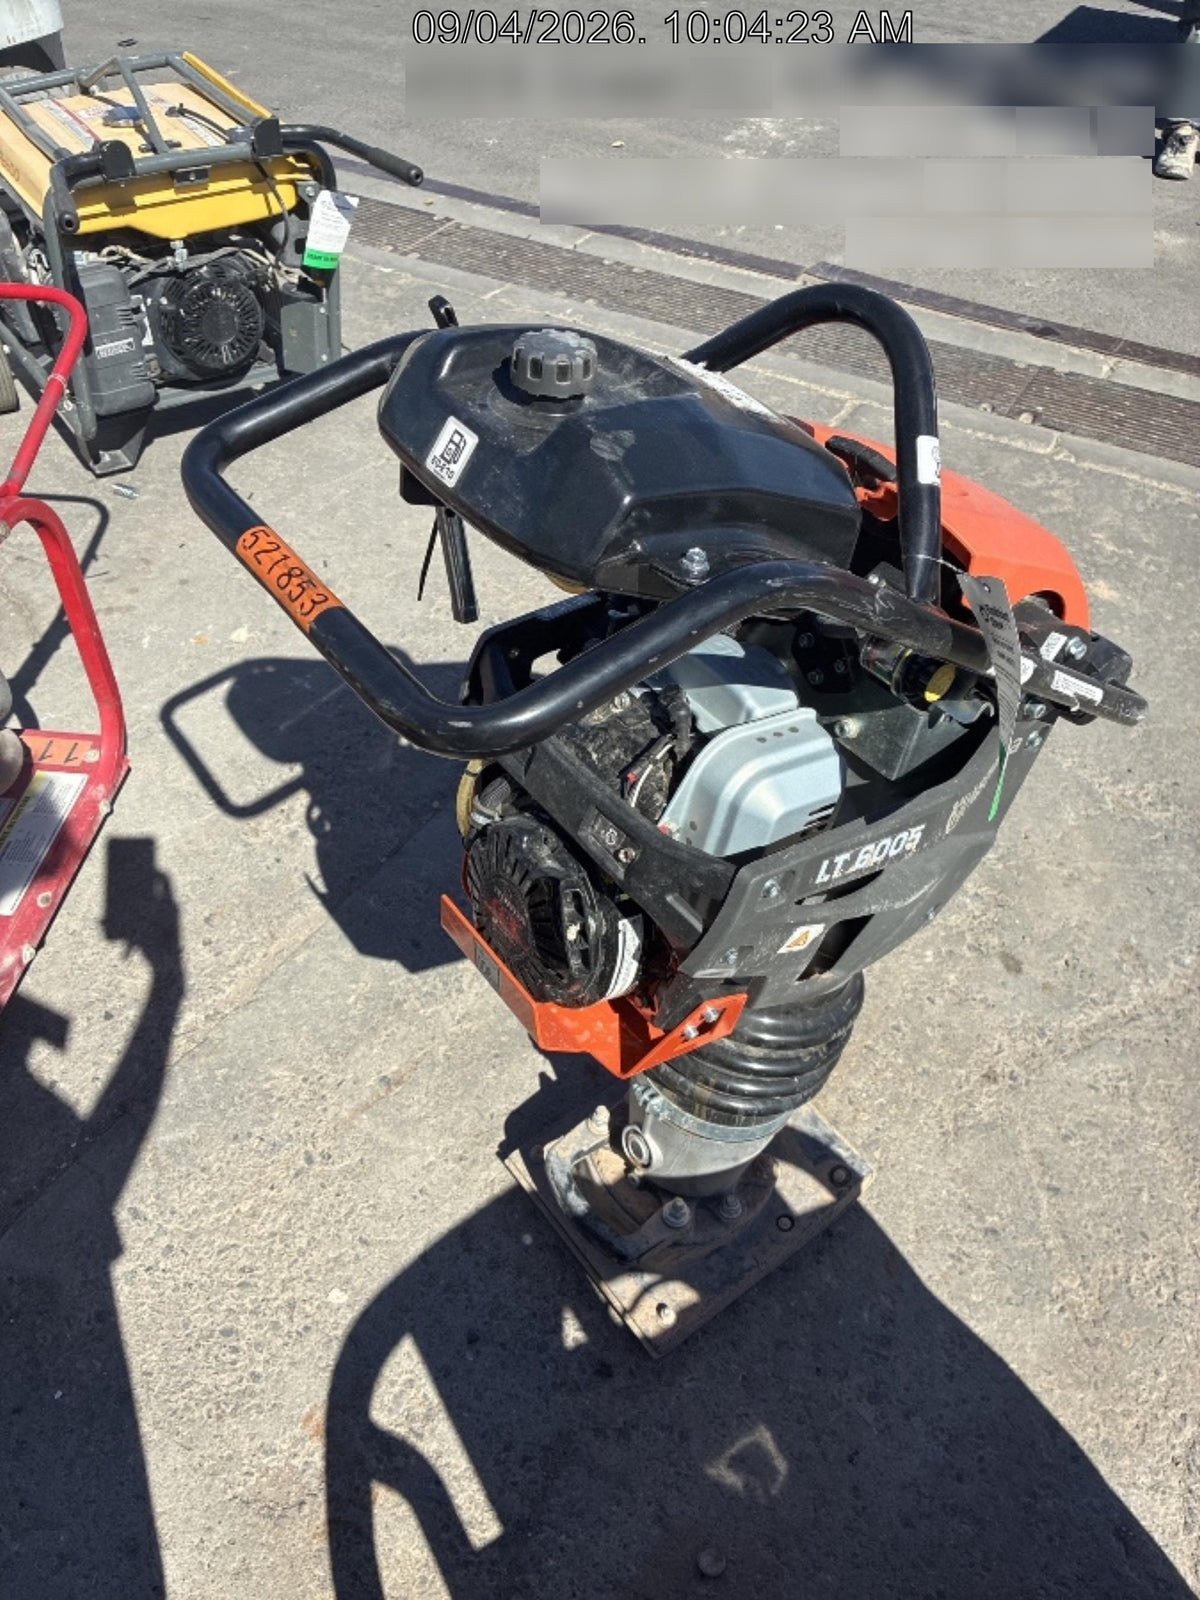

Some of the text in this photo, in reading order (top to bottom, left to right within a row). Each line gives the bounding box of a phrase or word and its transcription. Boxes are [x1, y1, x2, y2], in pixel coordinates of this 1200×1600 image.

[242, 529, 329, 616] 521853
[815, 823, 926, 884] LT 6005
